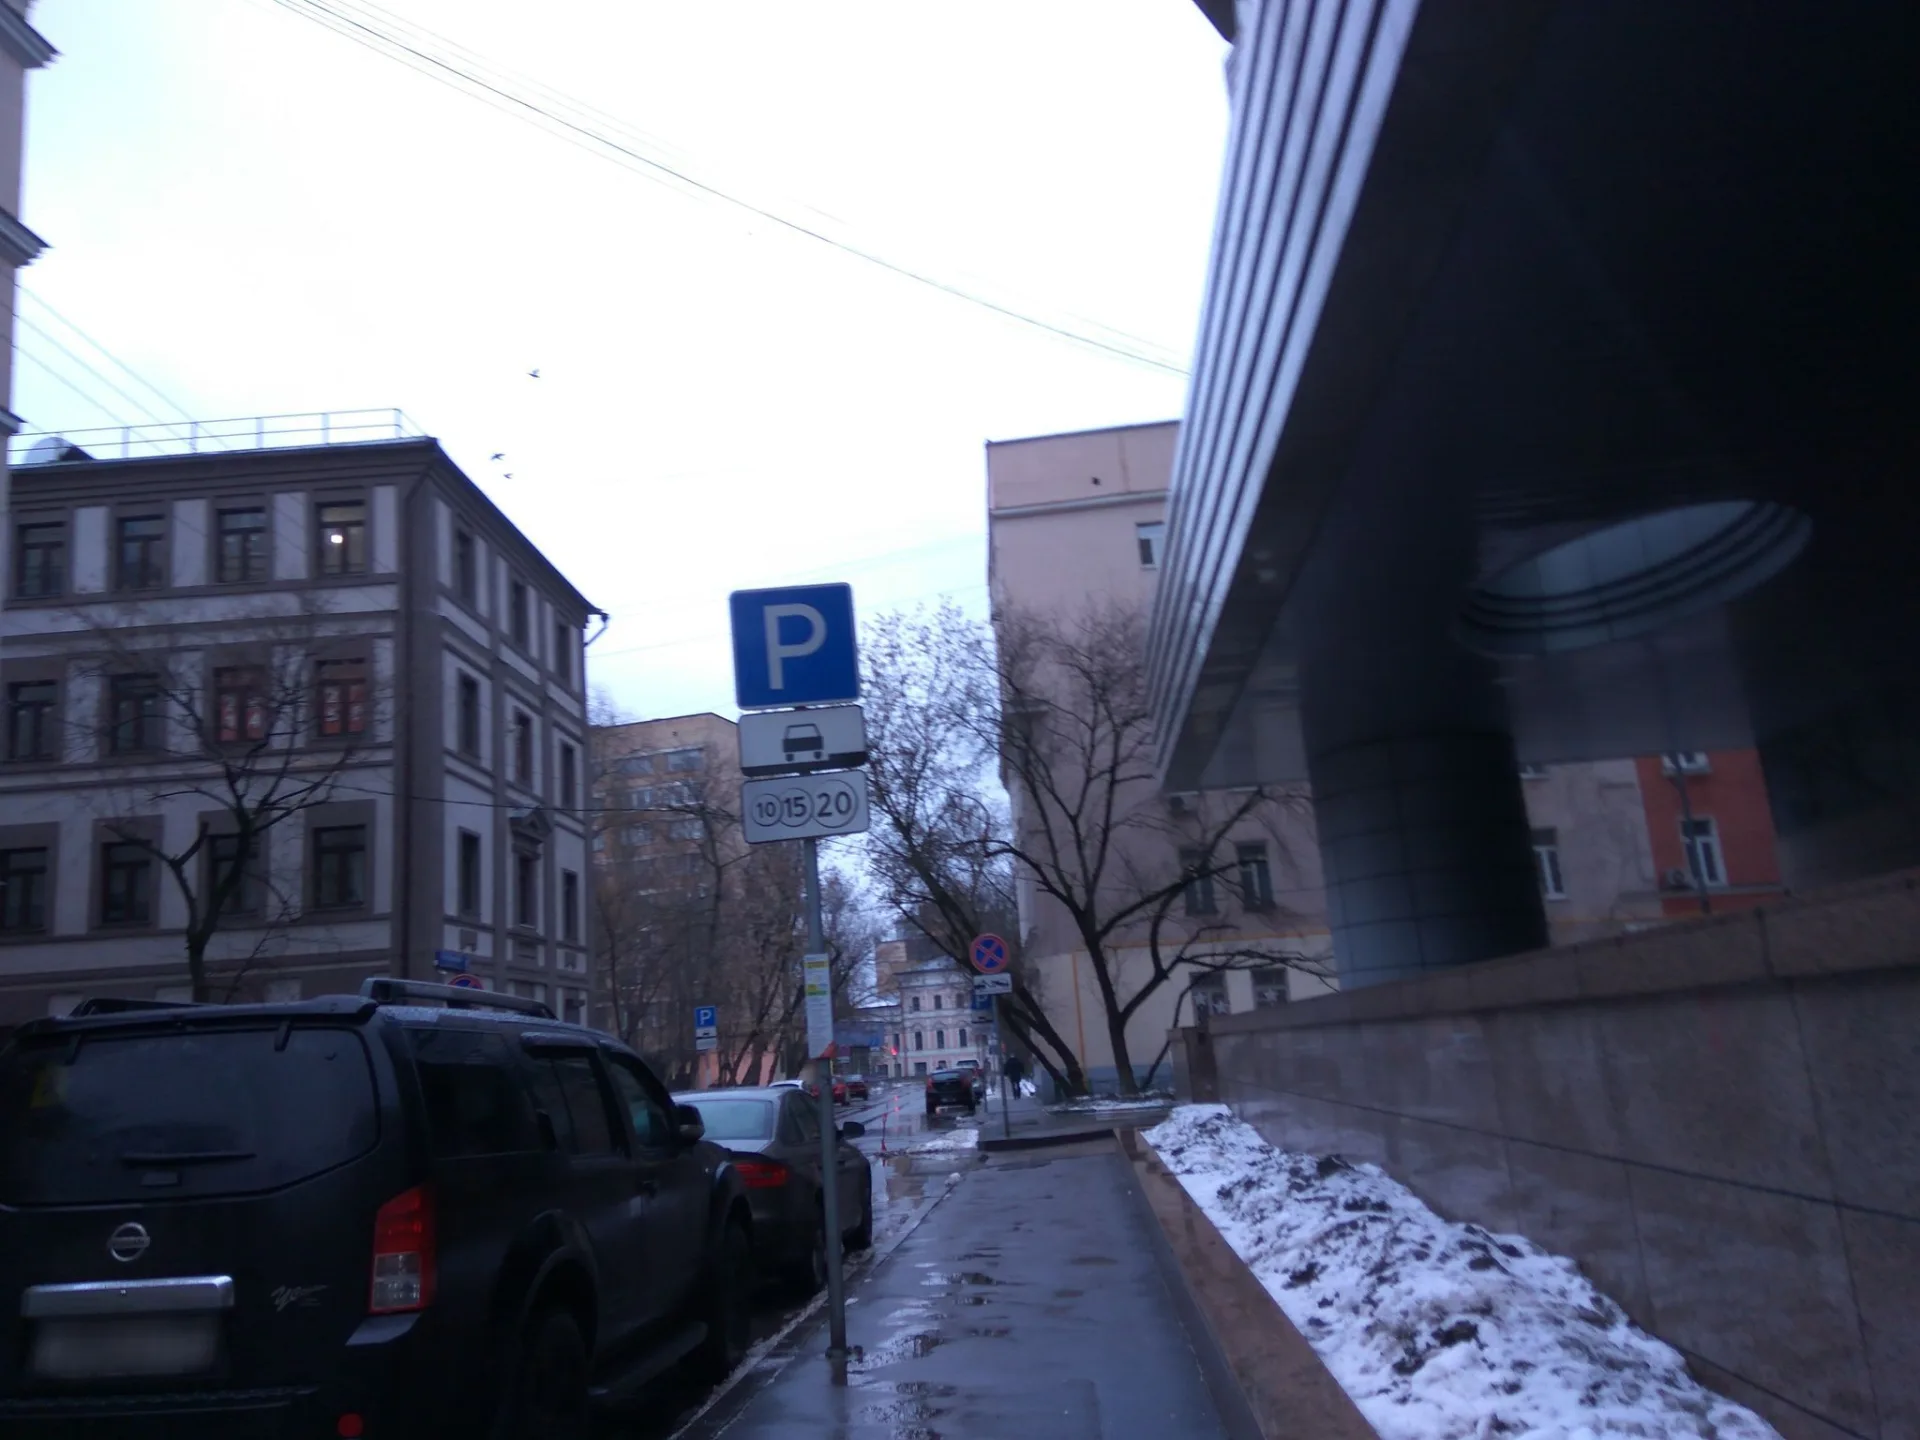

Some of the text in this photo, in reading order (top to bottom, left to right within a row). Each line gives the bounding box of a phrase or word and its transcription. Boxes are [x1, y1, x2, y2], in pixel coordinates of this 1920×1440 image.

[763, 602, 827, 690] P
[756, 791, 852, 818] 10 15 20
[699, 1009, 712, 1026] P
